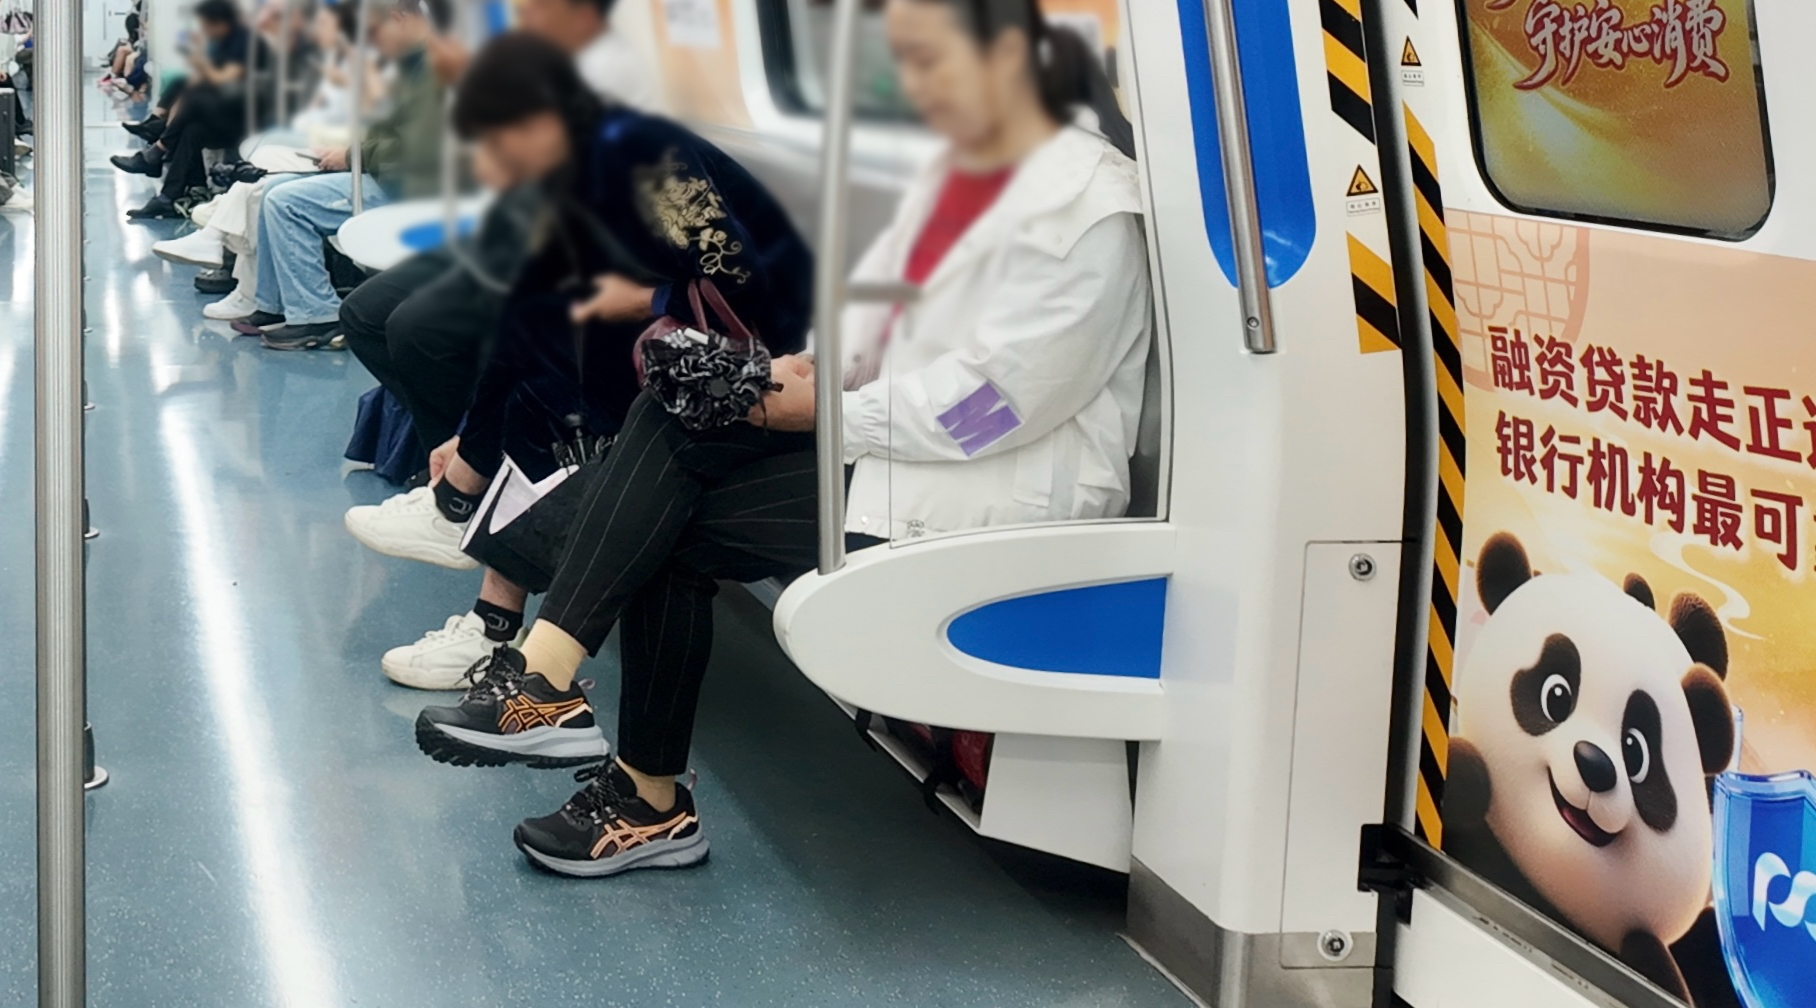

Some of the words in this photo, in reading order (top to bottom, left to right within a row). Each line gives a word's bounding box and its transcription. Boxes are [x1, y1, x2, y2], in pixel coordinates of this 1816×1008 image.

[1488, 325, 1816, 470] 融资贷款走正
[1495, 410, 1816, 572] 银行机构最可
